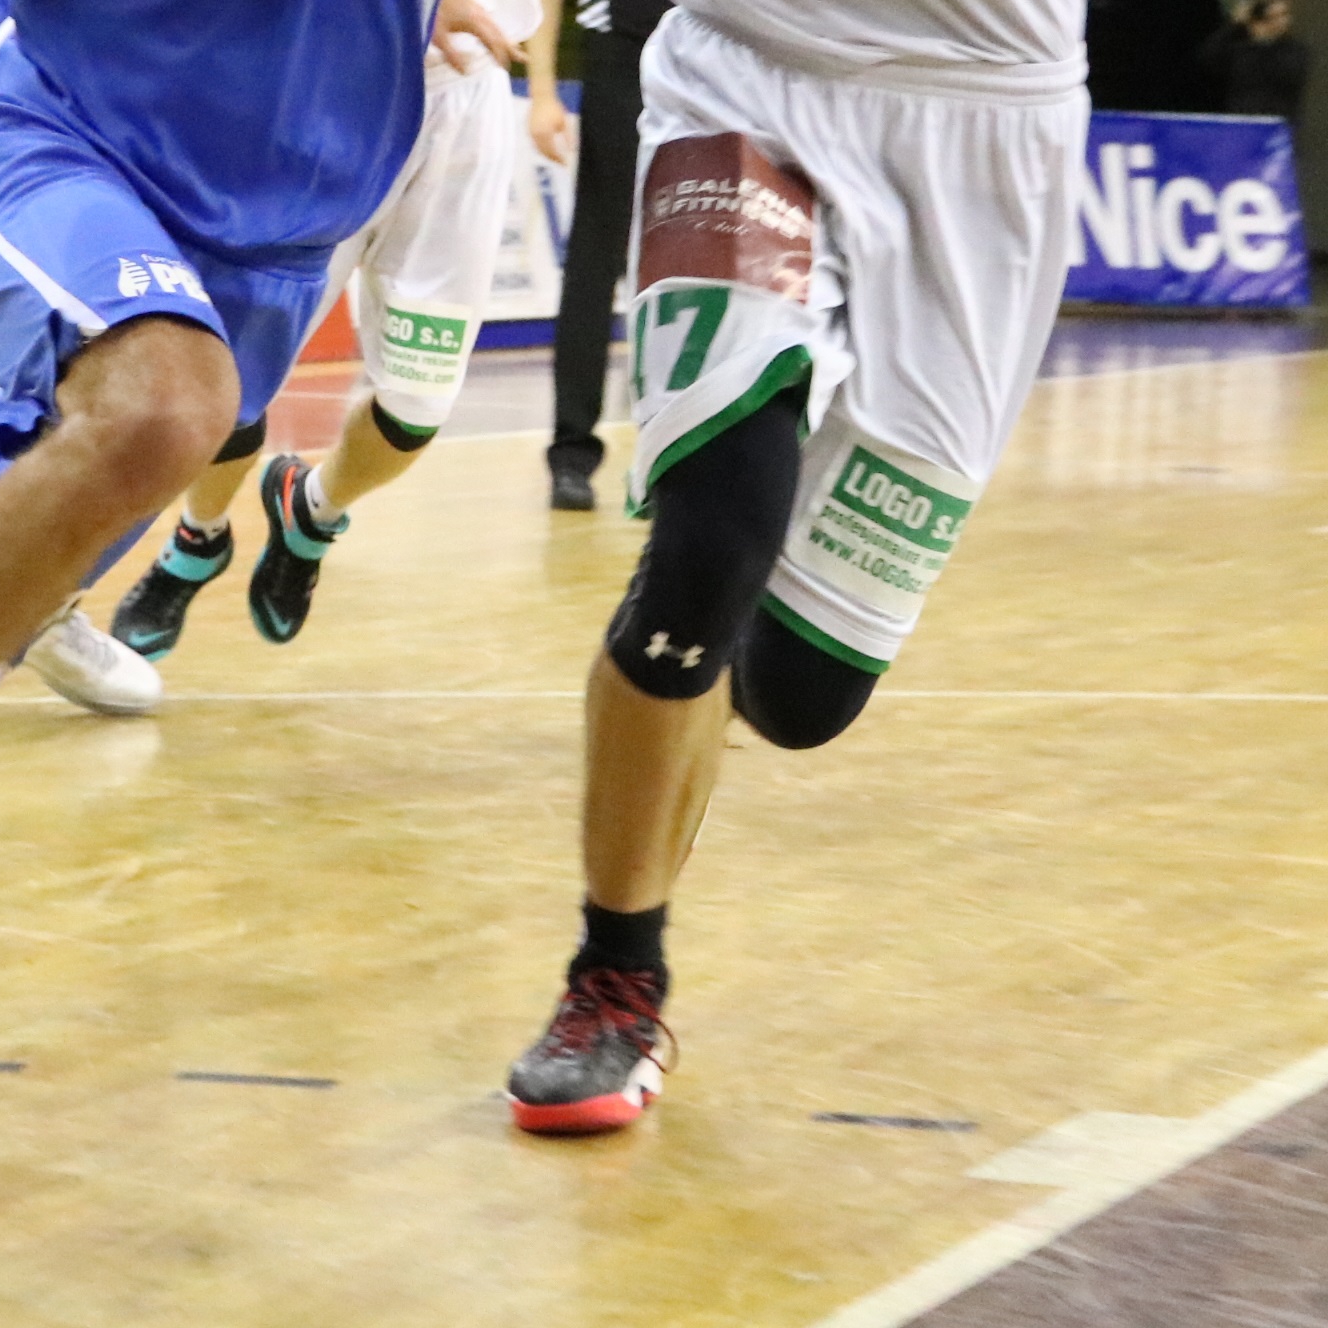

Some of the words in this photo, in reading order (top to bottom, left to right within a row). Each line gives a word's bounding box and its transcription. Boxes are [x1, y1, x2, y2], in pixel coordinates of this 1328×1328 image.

[1066, 142, 1291, 272] Nice
[419, 326, 460, 348] s.c.
[843, 461, 933, 530] LOGO
